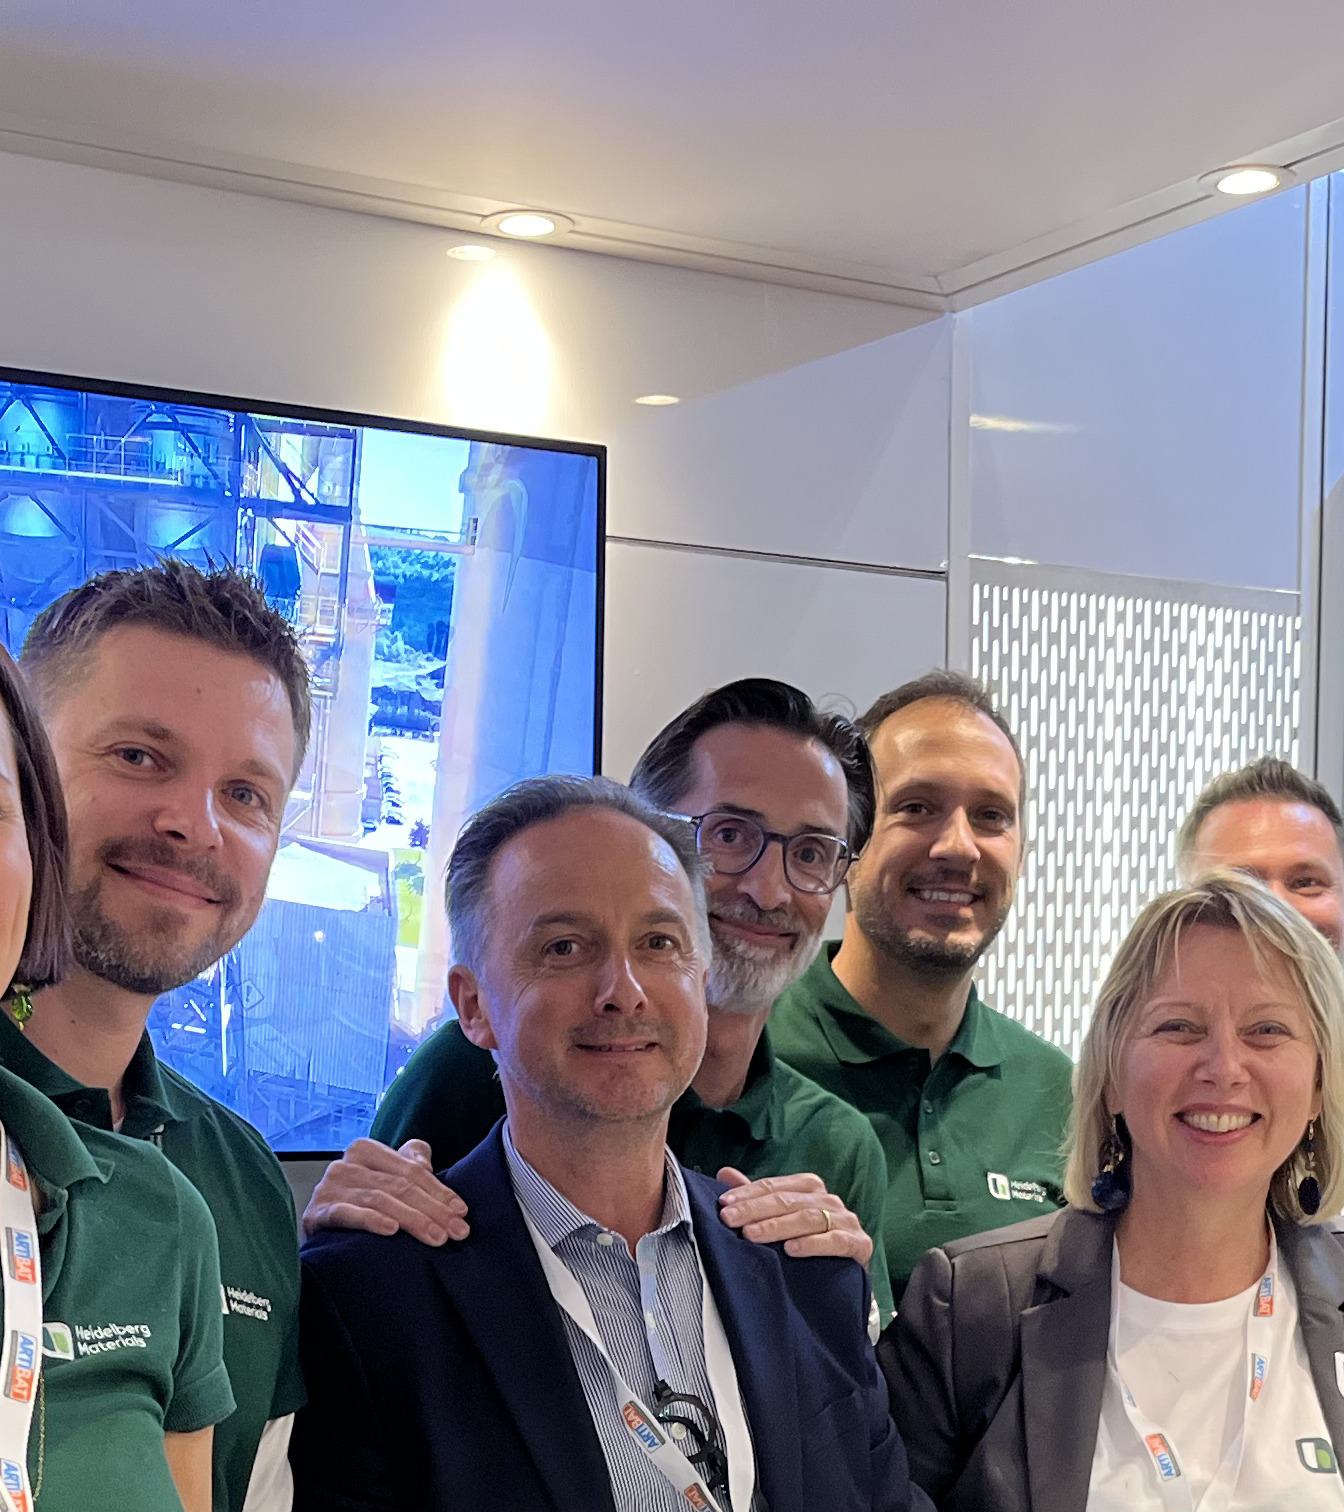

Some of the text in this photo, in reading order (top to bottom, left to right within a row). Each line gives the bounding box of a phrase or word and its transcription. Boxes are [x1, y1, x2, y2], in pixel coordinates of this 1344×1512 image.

[11, 1230, 36, 1282] ARTIBAT
[227, 1286, 271, 1312] Heidelberg
[229, 1299, 268, 1321] Materials
[75, 1323, 151, 1338] Heidelberg
[77, 1335, 146, 1355] Materials
[8, 1334, 36, 1400] ARTIBAT
